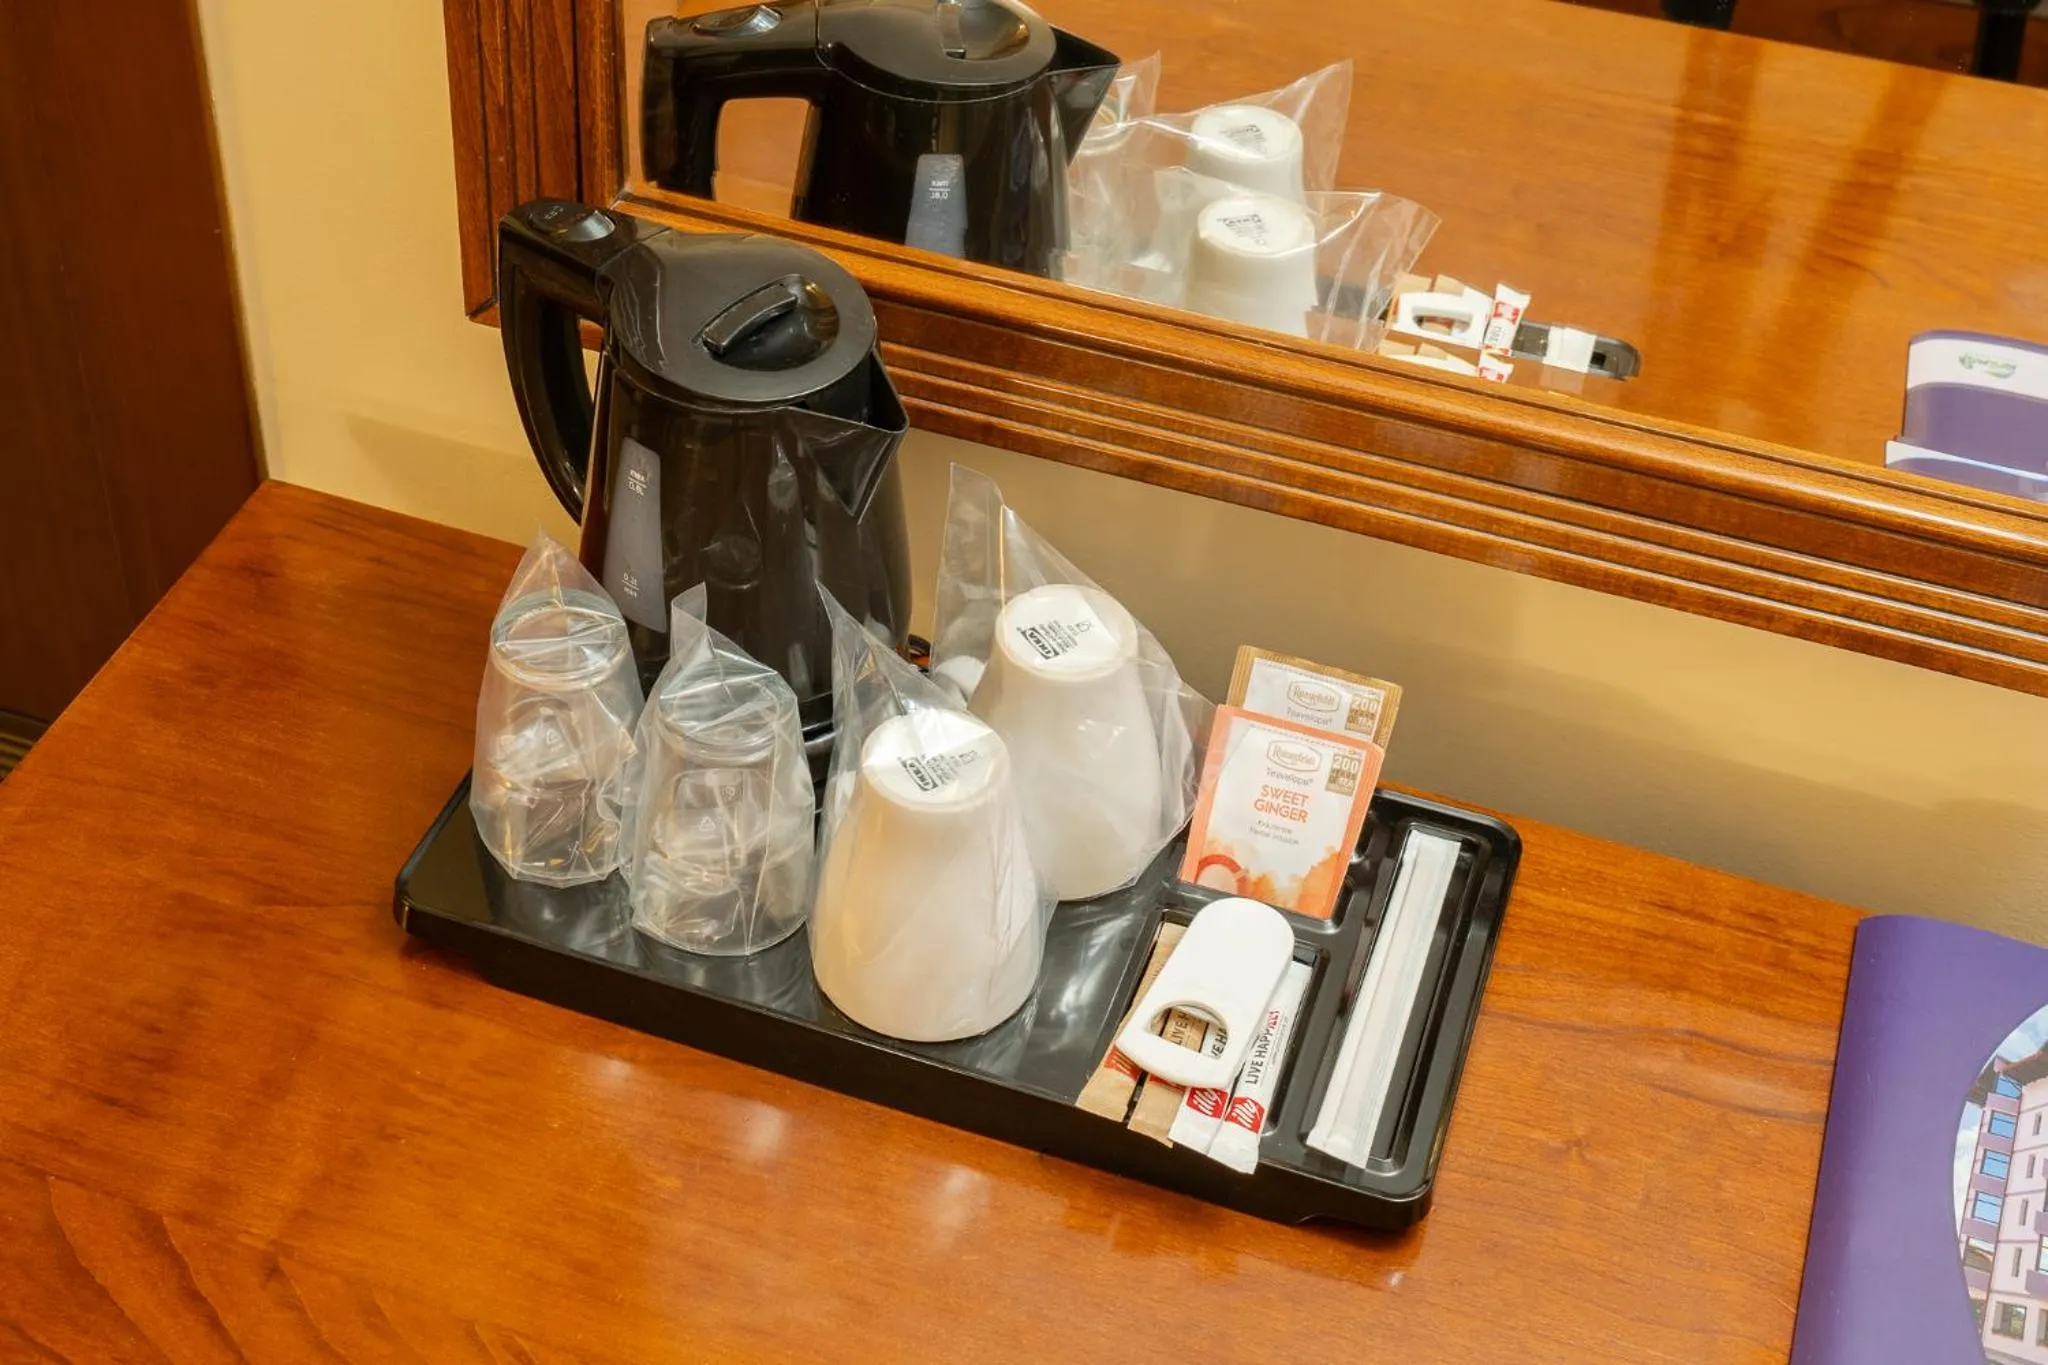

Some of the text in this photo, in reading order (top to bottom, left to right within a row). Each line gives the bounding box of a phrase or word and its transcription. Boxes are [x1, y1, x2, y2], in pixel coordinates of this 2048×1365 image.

[1332, 755, 1359, 774] 200
[1260, 784, 1310, 809] SWEET
[1254, 798, 1309, 824] GINGER
[1245, 1060, 1264, 1085] LIVE
[1230, 1098, 1261, 1130] illy
